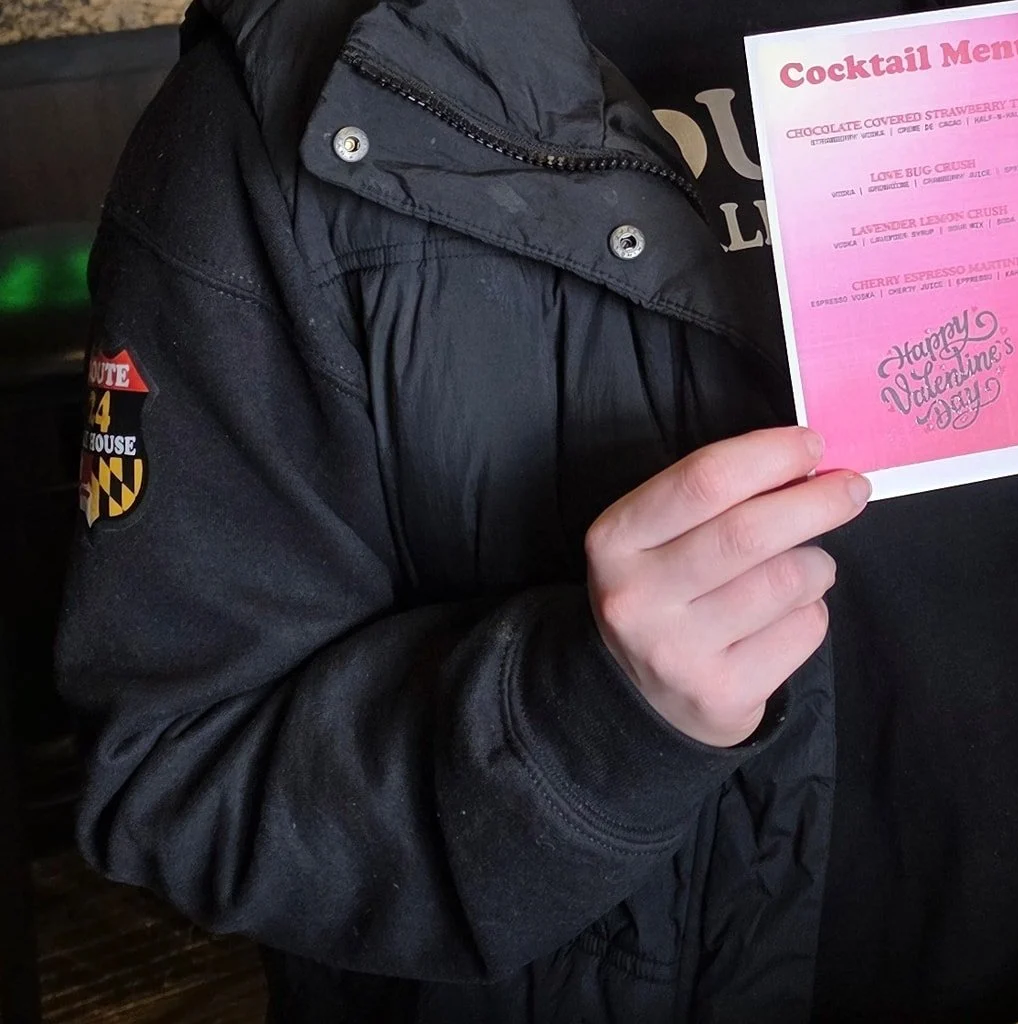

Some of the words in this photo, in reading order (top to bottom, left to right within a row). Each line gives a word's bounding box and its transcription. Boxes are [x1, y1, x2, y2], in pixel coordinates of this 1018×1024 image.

[780, 45, 931, 88] Cocktail
[786, 120, 863, 139] CHOCOLATE
[863, 112, 921, 129] COVERED
[924, 99, 1008, 121] STRAWBERRY
[870, 168, 904, 183] LOVE
[904, 165, 932, 179] BUG
[934, 158, 976, 174] CRUSH
[851, 218, 917, 237] LAVENDER
[919, 210, 965, 227] LEMON
[967, 204, 1009, 220] CRUSH
[810, 295, 848, 308] ESPRESSO
[920, 280, 944, 291] JUICE
[851, 275, 901, 291] CHERRY
[904, 265, 966, 284] ESPRESSO
[878, 309, 998, 379] Happy
[880, 337, 1015, 415] Valentine's
[916, 377, 1001, 430] Day
[89, 433, 136, 456] HOUSE
